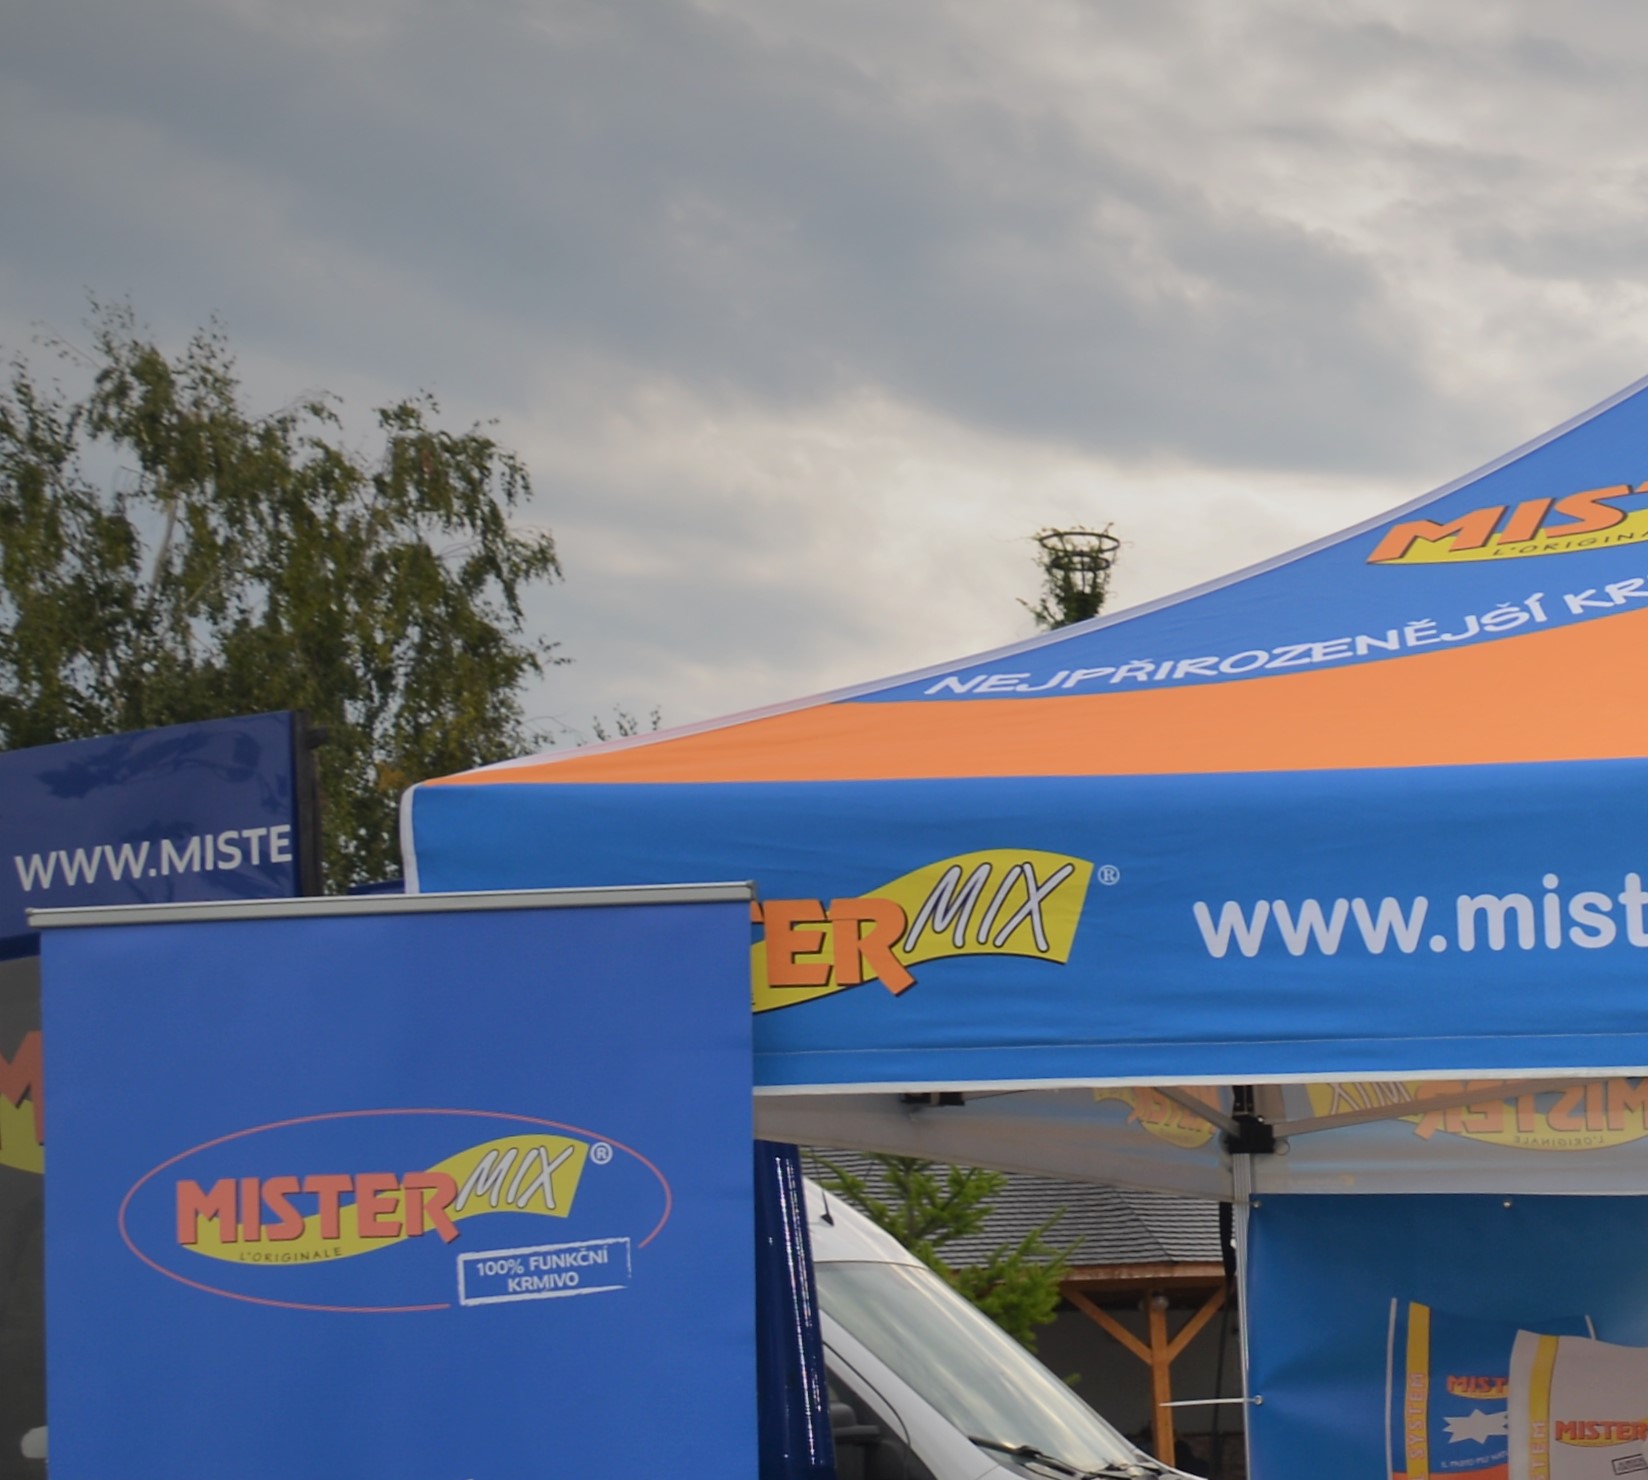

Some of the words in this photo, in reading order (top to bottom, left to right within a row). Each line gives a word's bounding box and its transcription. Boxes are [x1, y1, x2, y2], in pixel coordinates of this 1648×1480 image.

[924, 590, 1548, 695] NEJPŘIROZENĚJŠÍ
[903, 862, 1074, 953] MIX
[175, 1172, 460, 1244] MISTER
[455, 1146, 575, 1211] MIX
[239, 1246, 343, 1265] L'ORIGINALE
[476, 1258, 525, 1277] 100%
[529, 1246, 608, 1272] FUNKČNÍ
[507, 1272, 579, 1293] KRMIVO
[1408, 1372, 1426, 1459] SYSTEM
